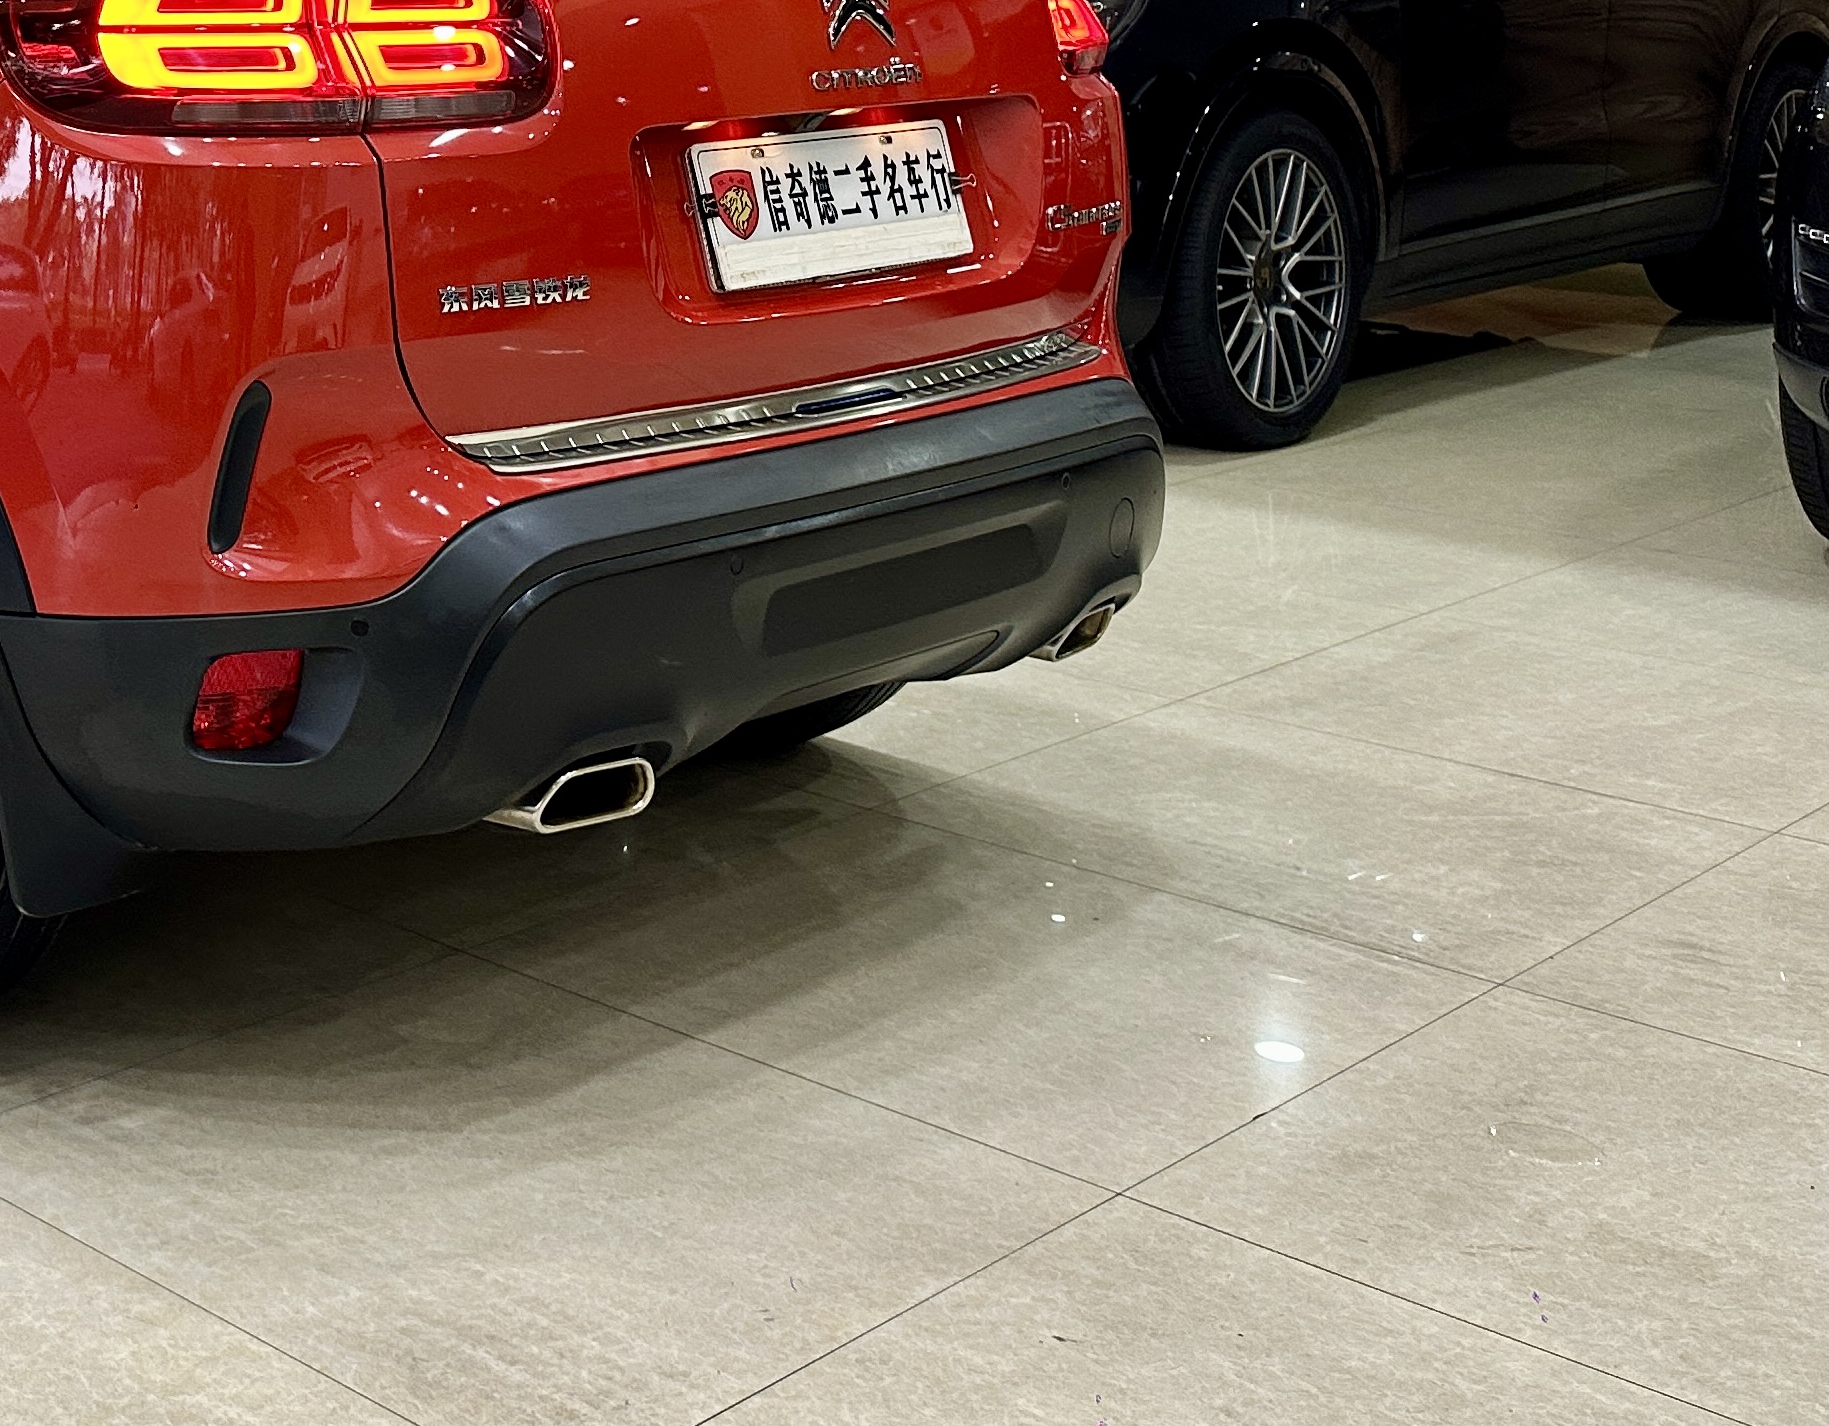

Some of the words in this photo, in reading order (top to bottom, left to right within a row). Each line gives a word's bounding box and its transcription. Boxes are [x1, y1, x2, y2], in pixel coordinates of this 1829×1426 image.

[759, 148, 952, 234] 信奇德二手名车行
[439, 274, 591, 313] 东风雪铁龙
